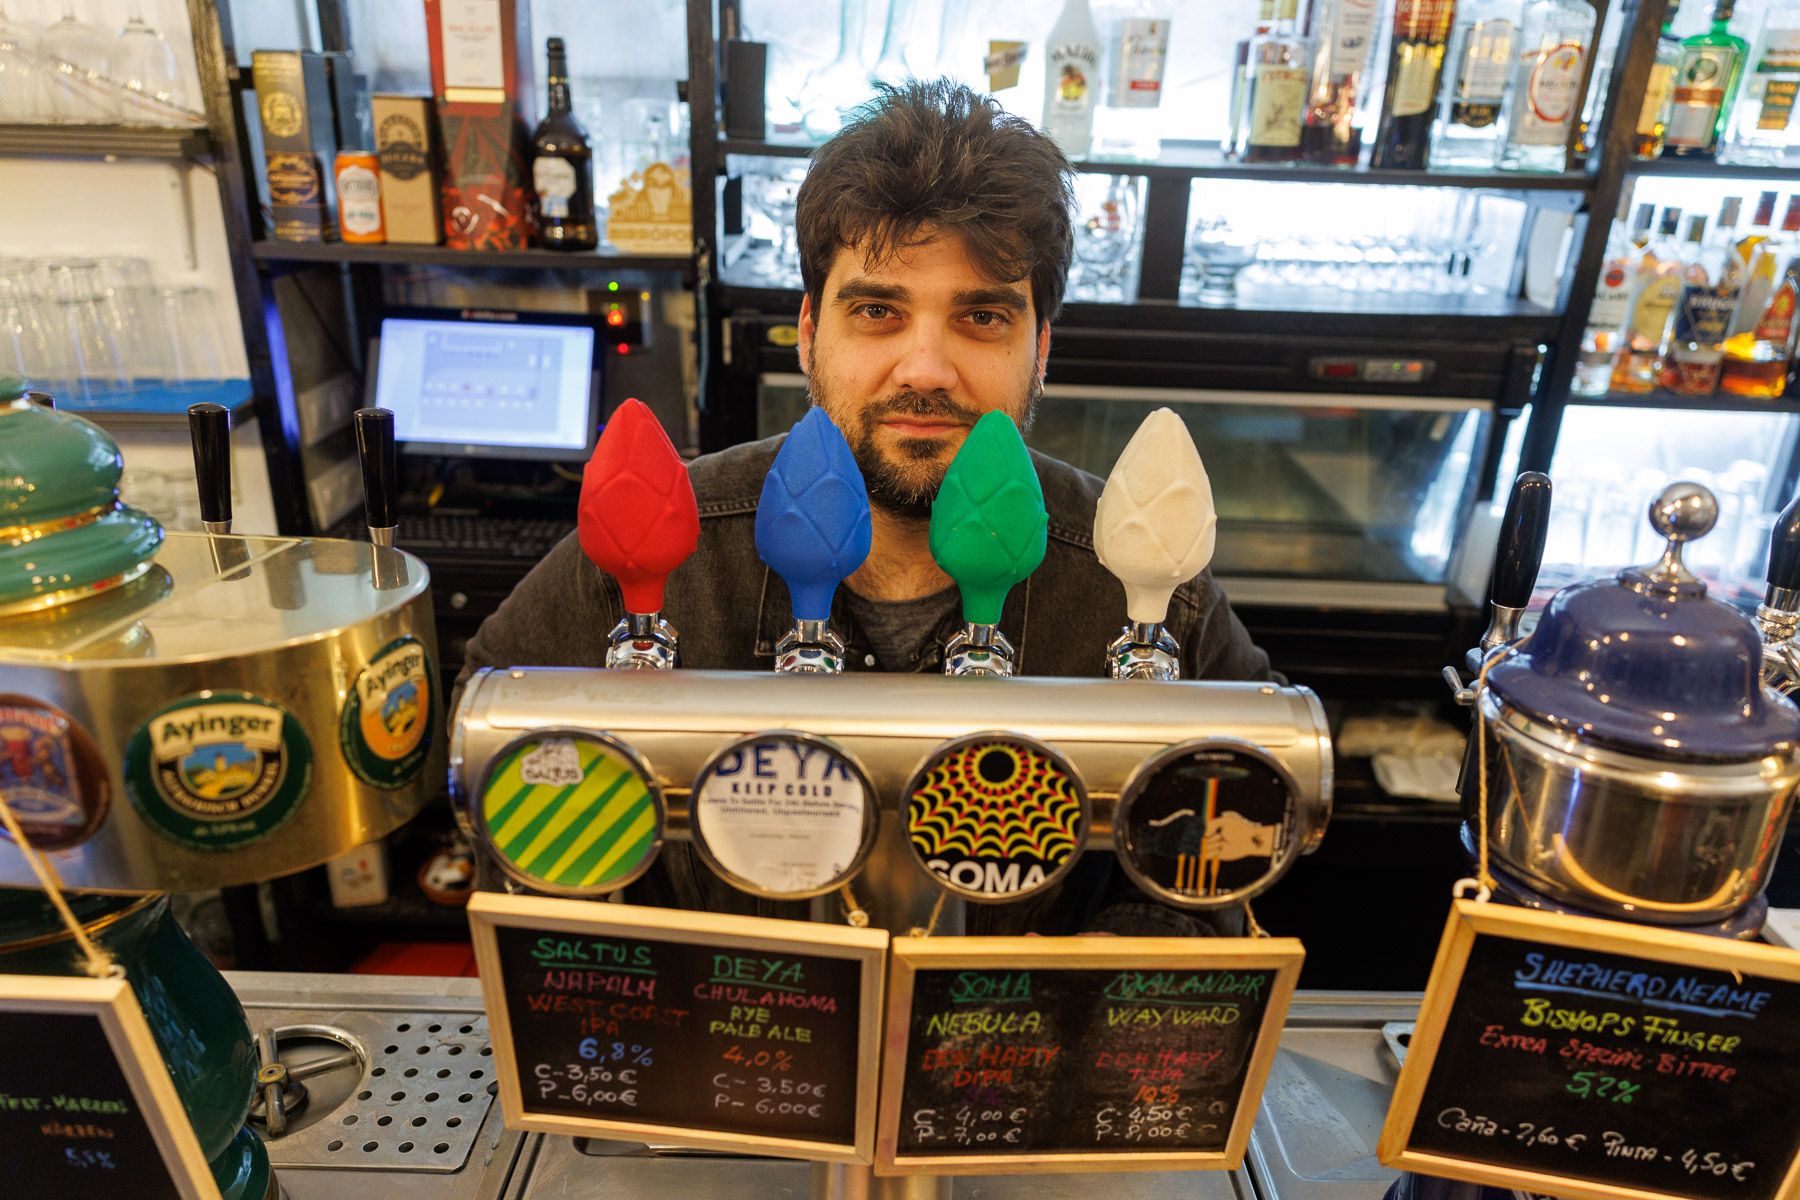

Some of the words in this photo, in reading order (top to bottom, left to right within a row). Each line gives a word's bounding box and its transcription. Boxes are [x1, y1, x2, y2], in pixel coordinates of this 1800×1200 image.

[162, 711, 274, 742] Ayinger
[714, 743, 854, 781] DEYA
[732, 783, 776, 796] KEEP
[785, 784, 833, 797] COLD
[927, 859, 1046, 893] SOMA
[531, 937, 653, 966] SALTUS
[712, 954, 805, 983] DEYA
[1514, 952, 1667, 997] SHEPHERD
[1670, 976, 1771, 1012] NEAME
[543, 970, 656, 1000] NAPALM
[693, 983, 838, 1013] CHULAHOMA
[950, 971, 1031, 998] SOMA
[527, 993, 602, 1013] WEST
[730, 1005, 771, 1023] RYE
[580, 1013, 620, 1036] IPA
[767, 1024, 813, 1043] ALE
[926, 1010, 1041, 1037] NEBULA
[953, 1069, 1013, 1088] DIPA
